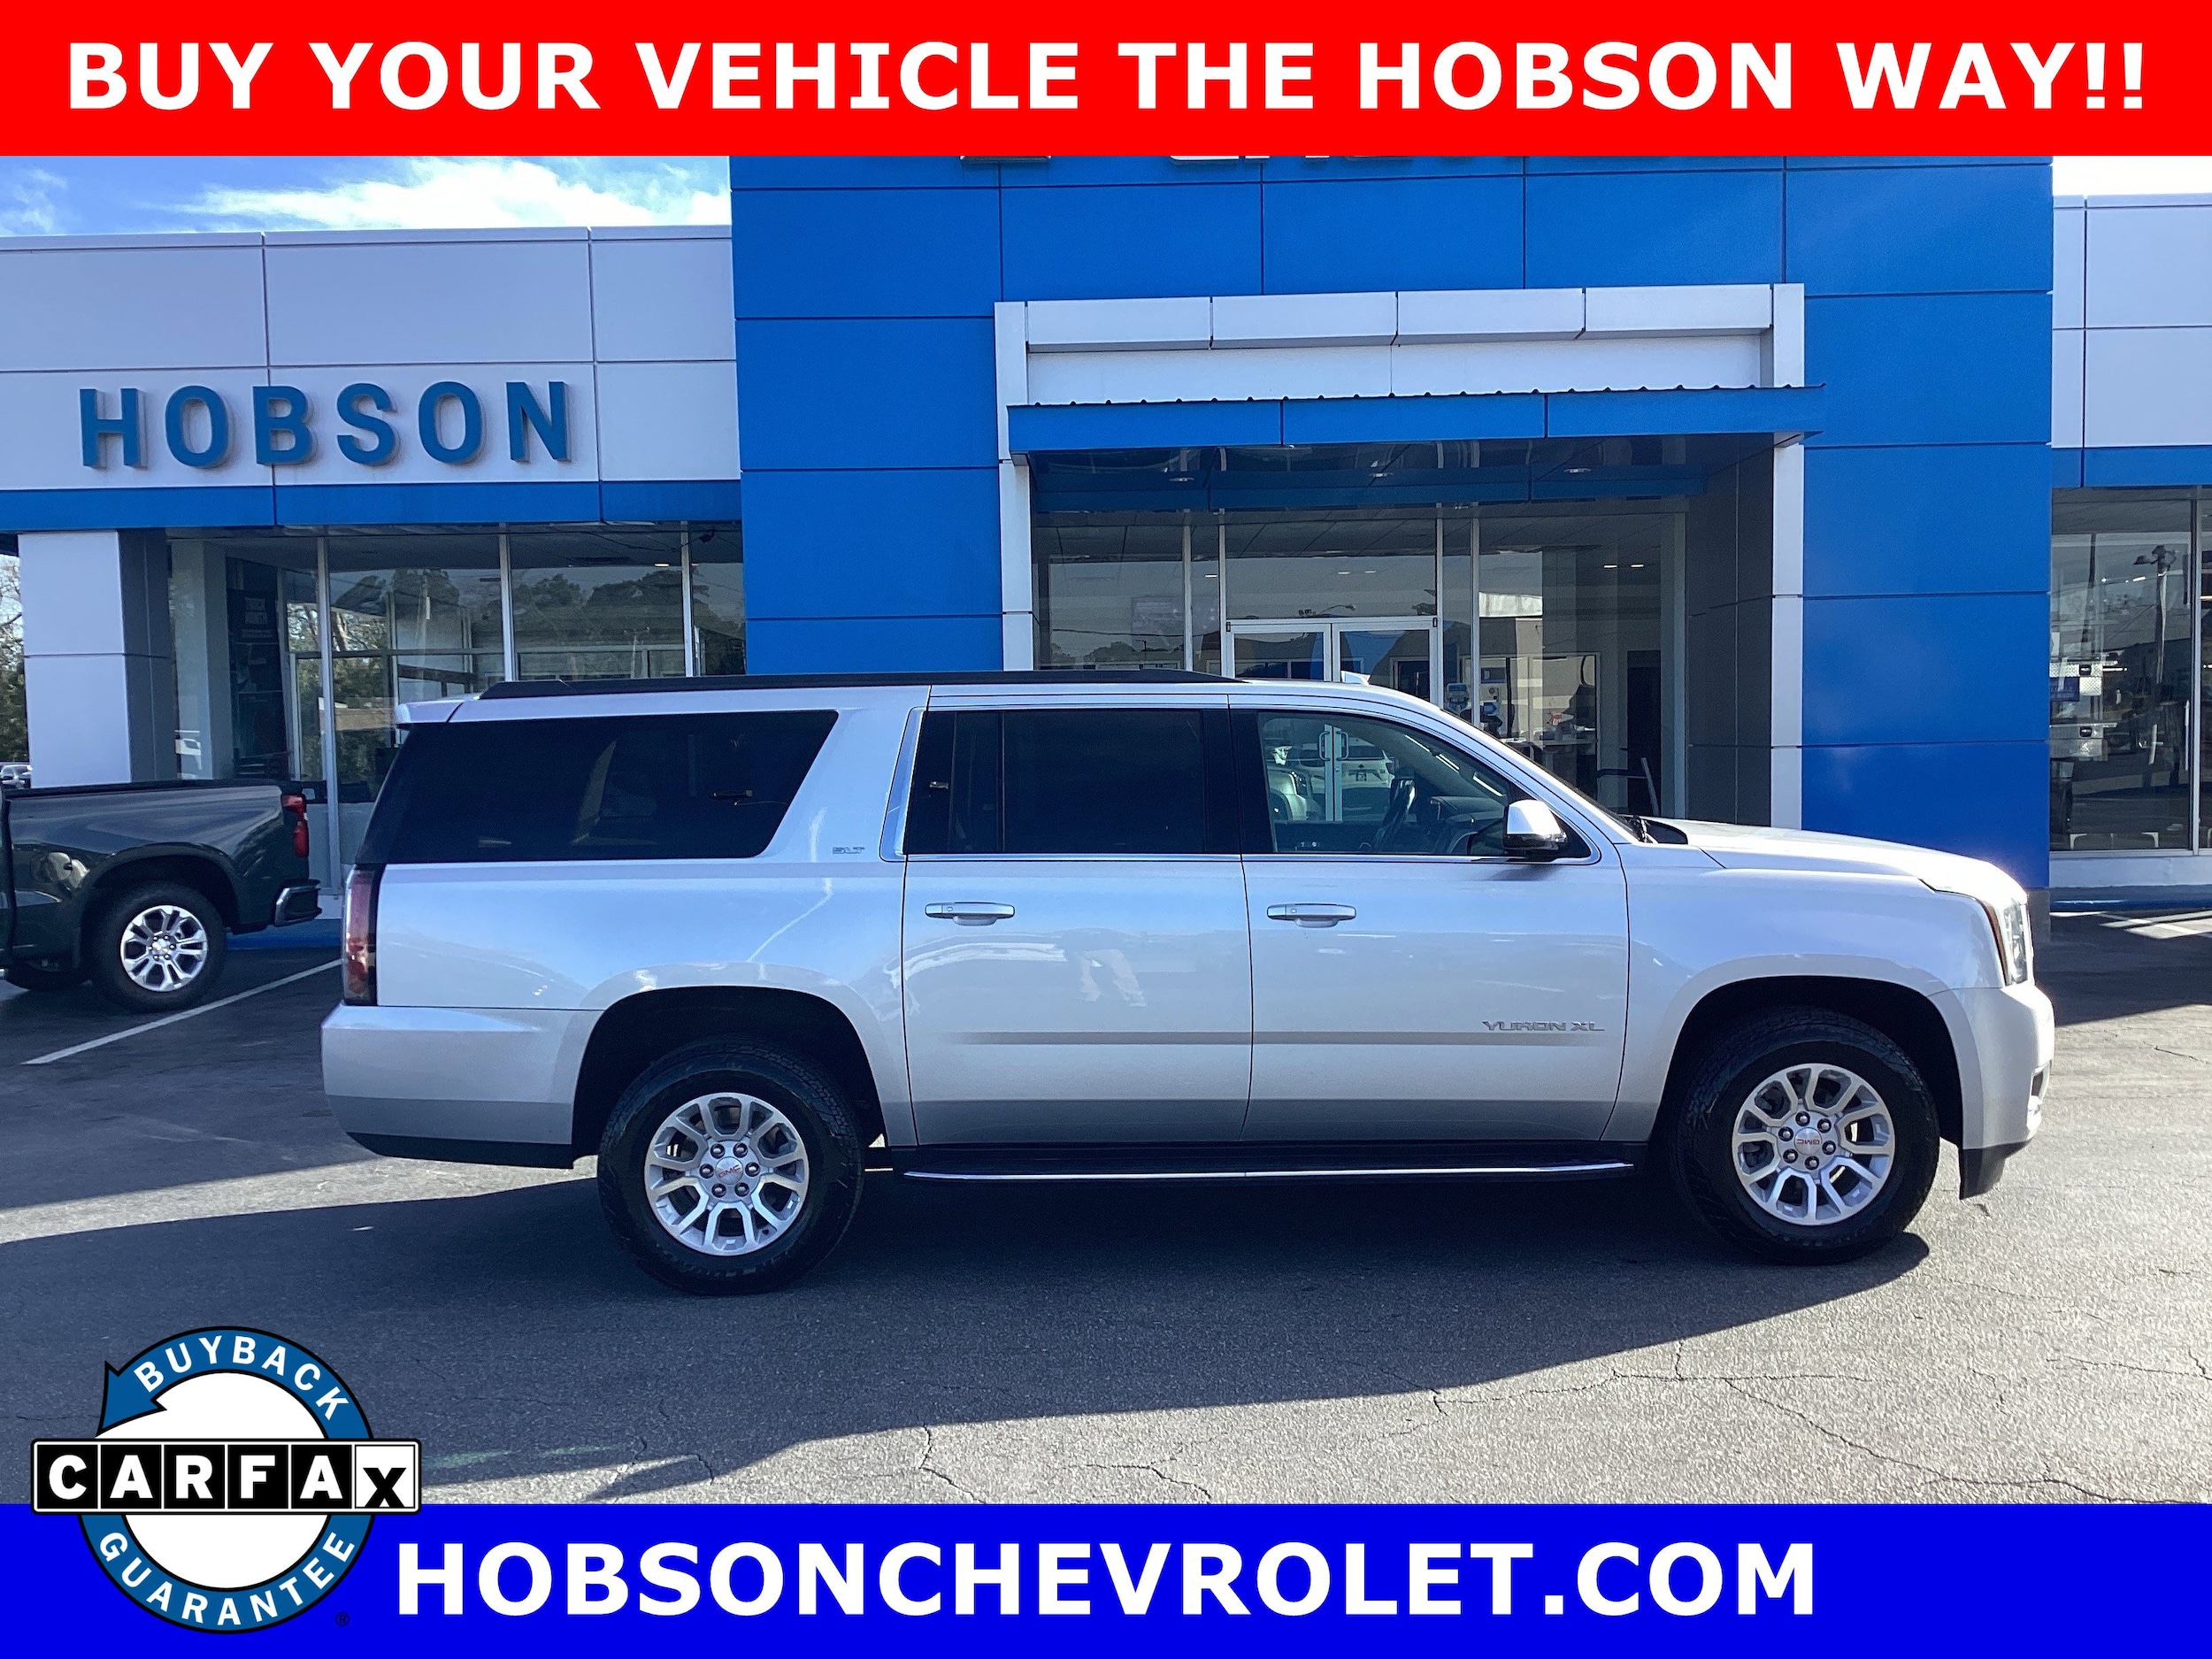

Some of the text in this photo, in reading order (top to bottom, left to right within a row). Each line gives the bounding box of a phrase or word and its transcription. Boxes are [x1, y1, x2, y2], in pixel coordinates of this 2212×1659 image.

[80, 380, 571, 469] HOBSON
[1481, 1020, 1605, 1032] YUKON XL
[718, 1164, 741, 1179] GMC
